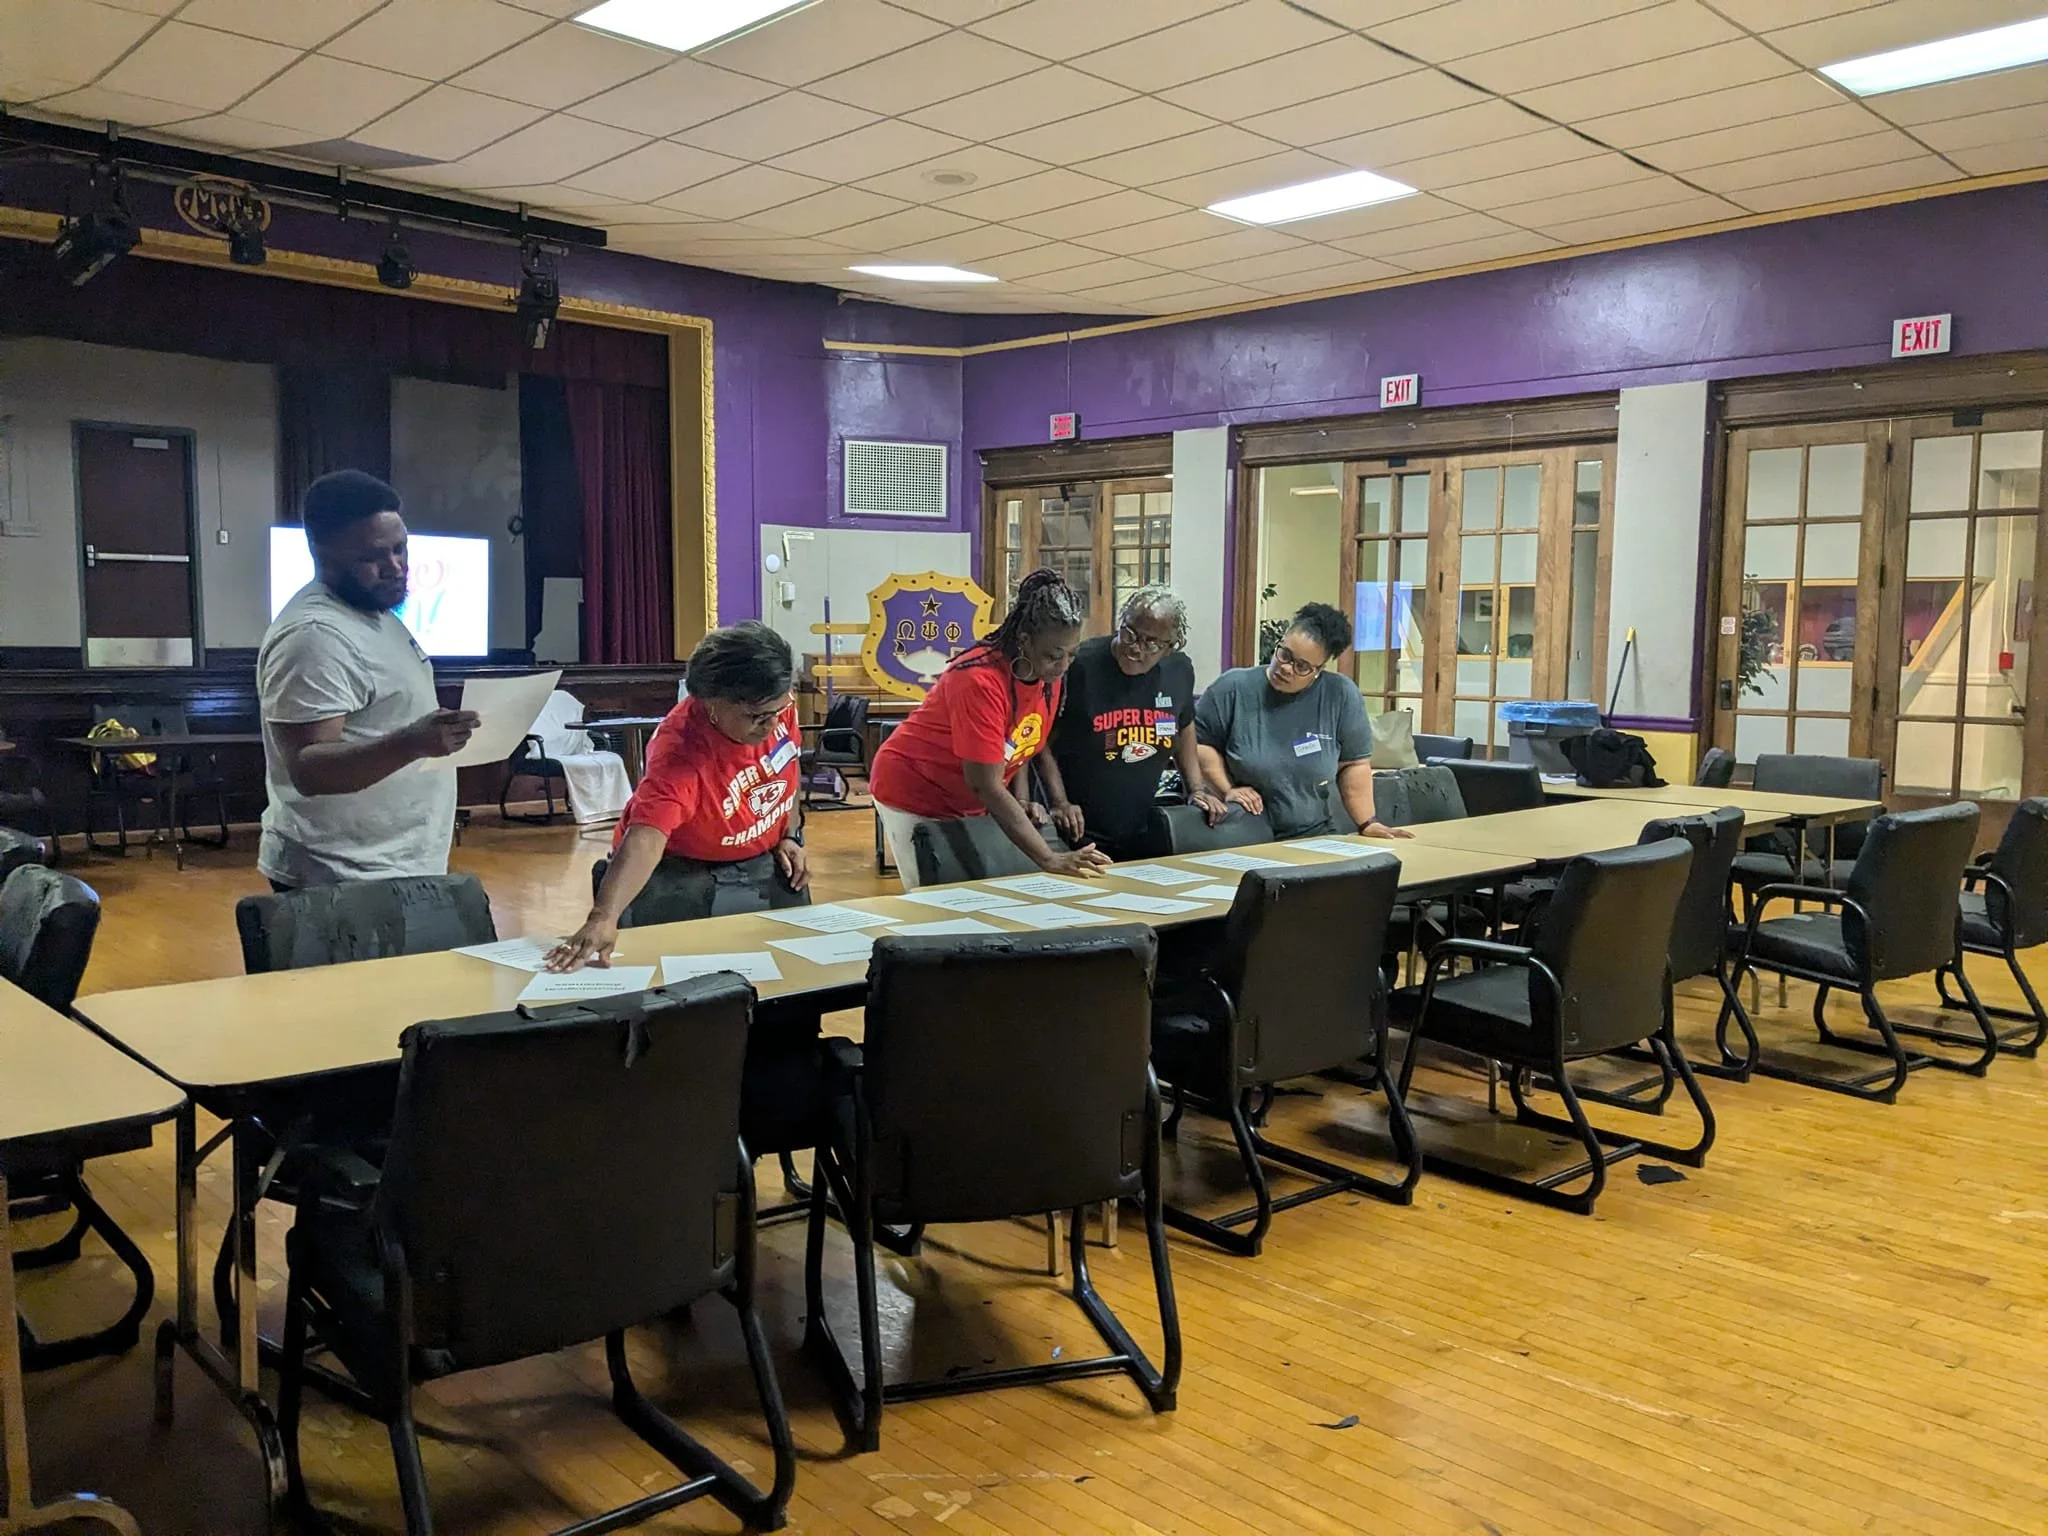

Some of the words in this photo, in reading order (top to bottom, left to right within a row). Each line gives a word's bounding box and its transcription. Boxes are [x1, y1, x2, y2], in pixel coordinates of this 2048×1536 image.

[1901, 319, 1942, 352] EXIT
[1386, 378, 1412, 403] EXIT
[1093, 708, 1141, 732] SUPER
[723, 765, 761, 820] SUPER
[721, 789, 797, 847] CHAMPIO
